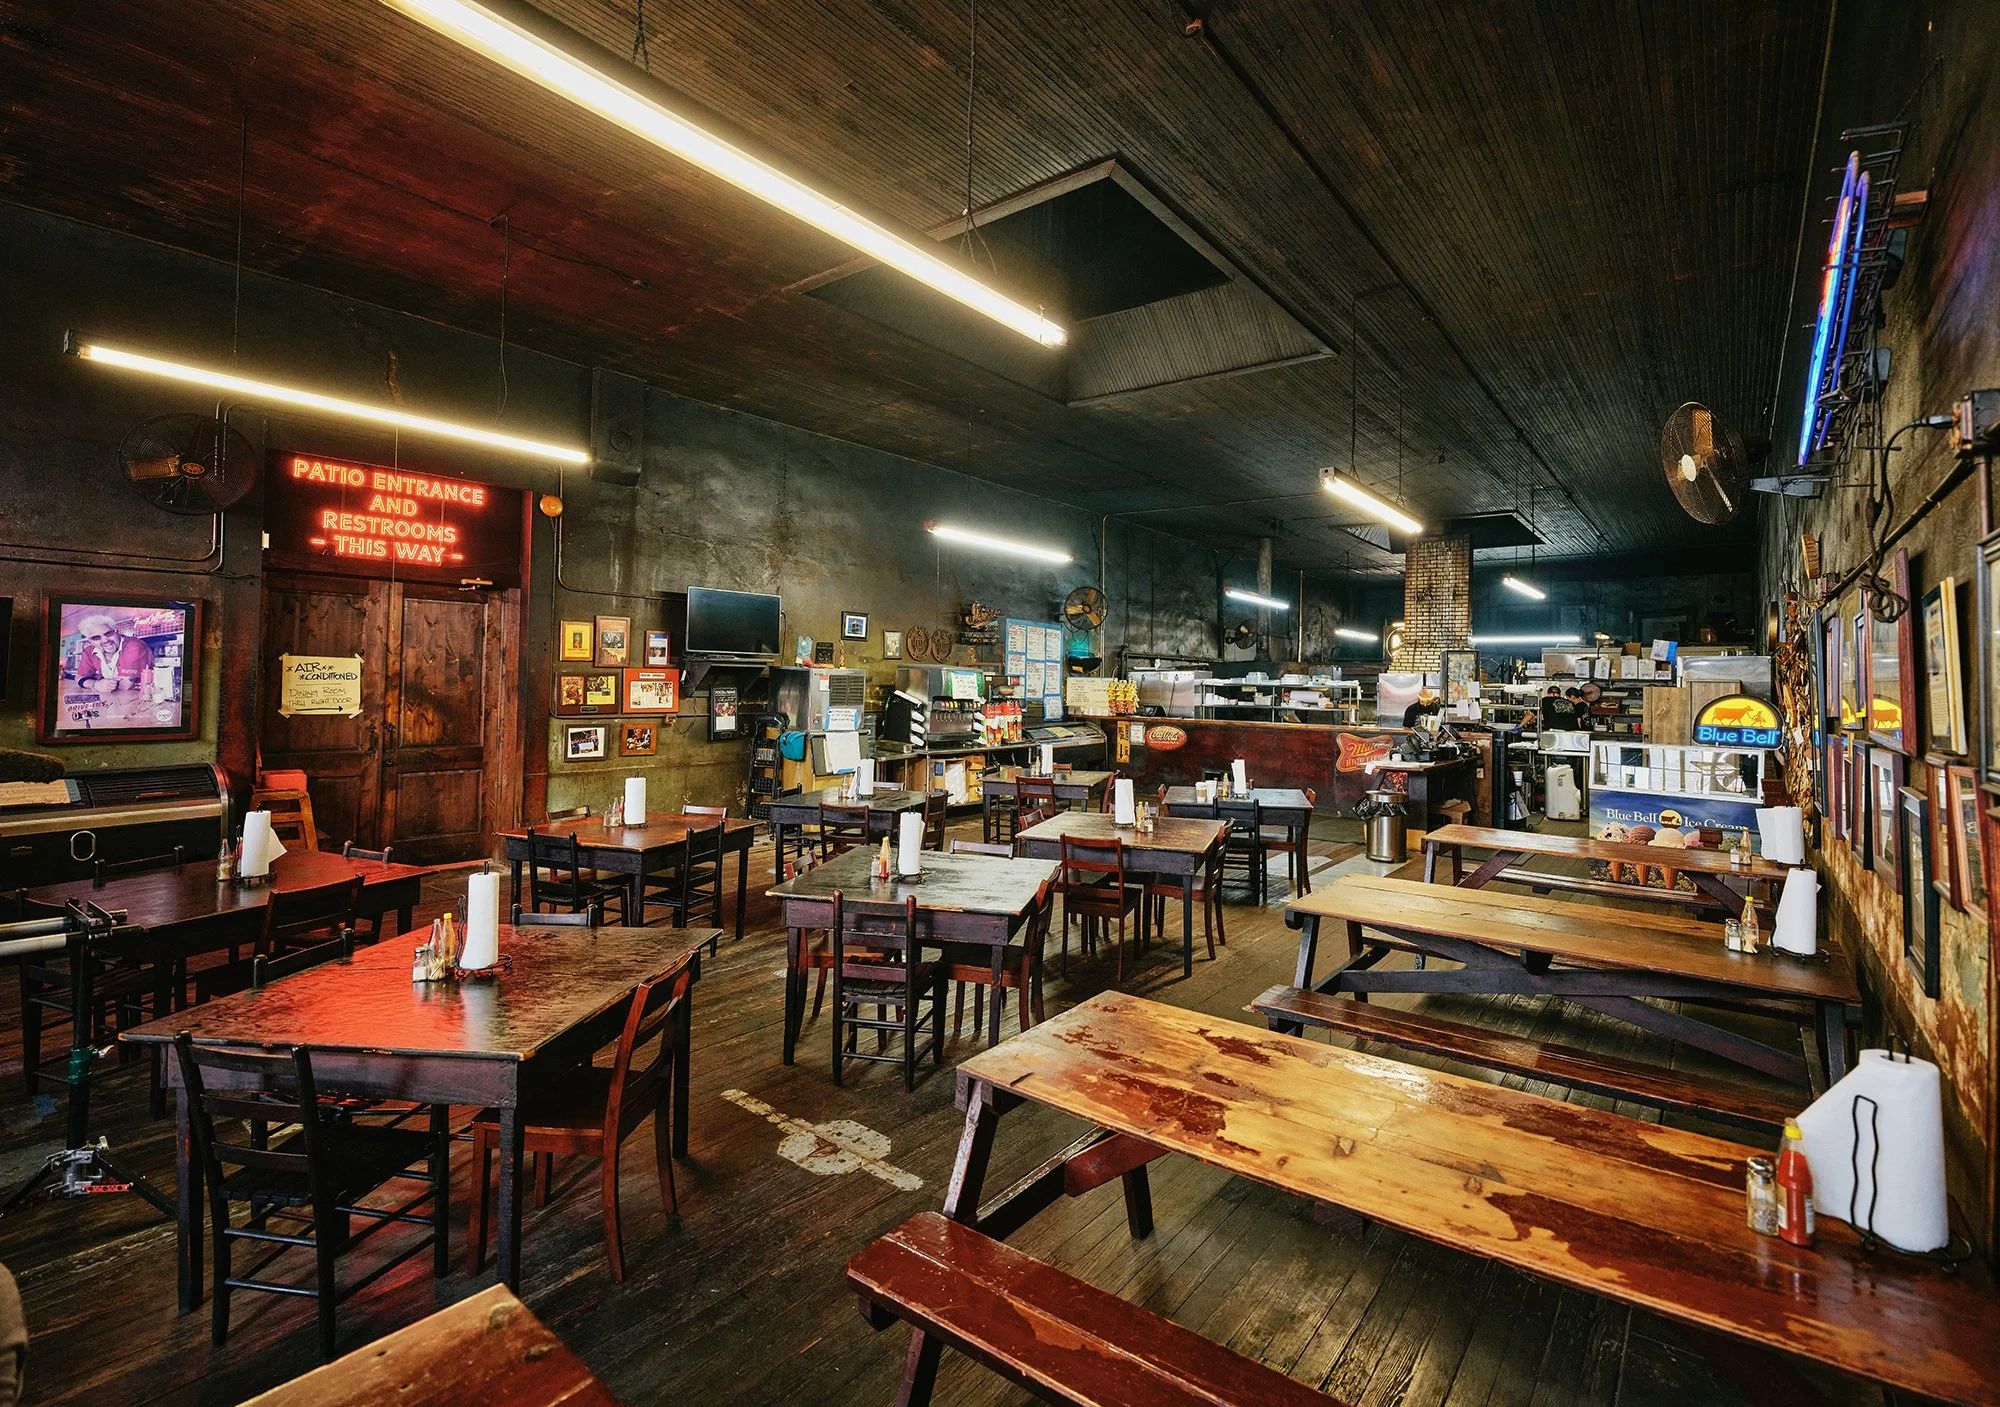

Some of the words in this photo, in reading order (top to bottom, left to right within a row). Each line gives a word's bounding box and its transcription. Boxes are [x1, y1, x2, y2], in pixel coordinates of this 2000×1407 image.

[293, 459, 364, 486] PATIO
[373, 472, 484, 505] ENTRANCE
[370, 494, 417, 517] AND
[322, 511, 457, 543] RESTROOMS
[334, 535, 386, 557] THIS
[395, 541, 445, 564] WAY
[1697, 726, 1738, 742] Blue
[1741, 728, 1776, 745] Bell
[1606, 808, 1632, 821] Blue
[1633, 810, 1657, 824] Bell
[1683, 816, 1702, 828] Ice
